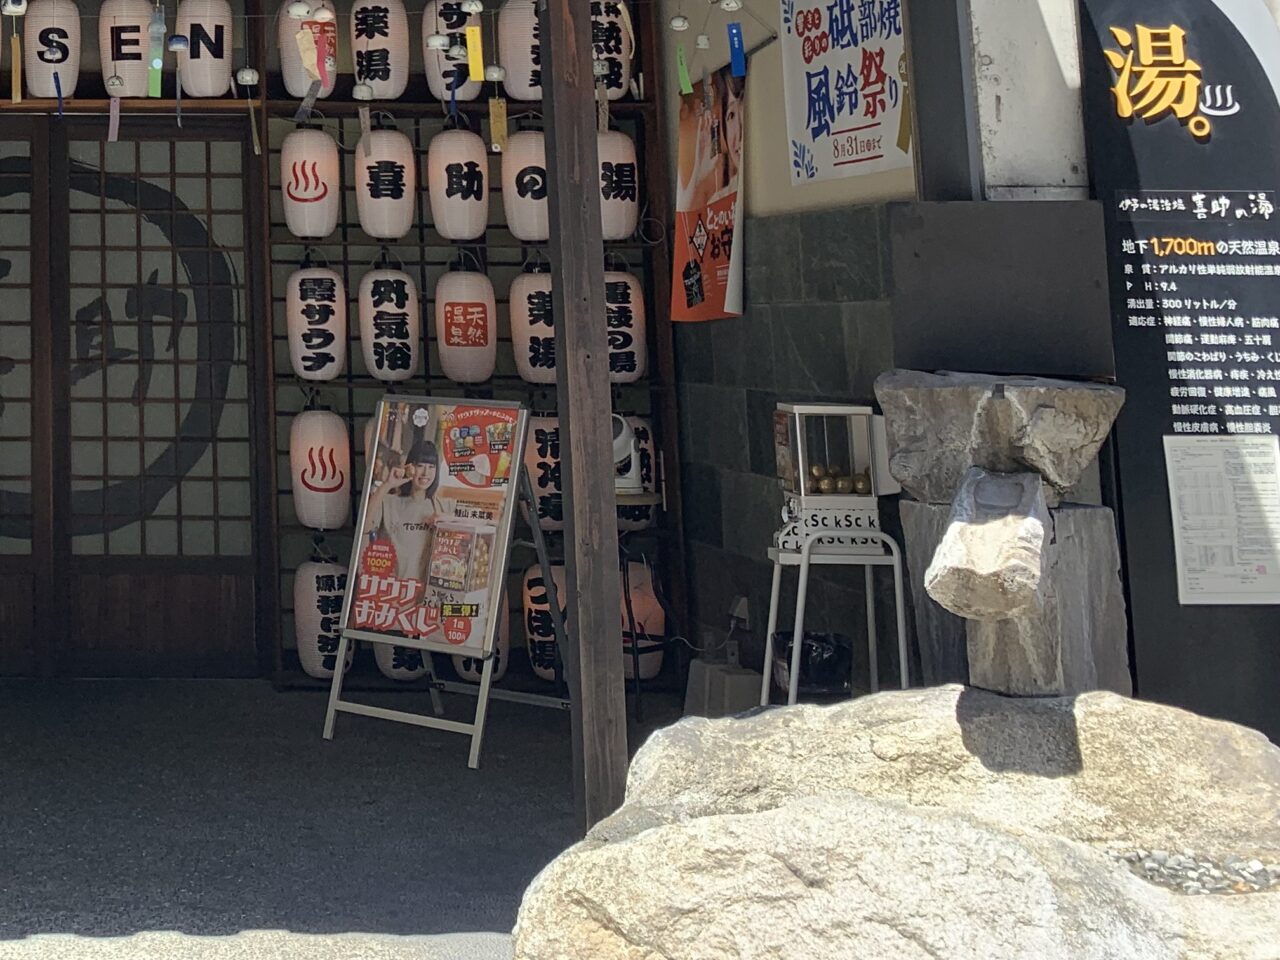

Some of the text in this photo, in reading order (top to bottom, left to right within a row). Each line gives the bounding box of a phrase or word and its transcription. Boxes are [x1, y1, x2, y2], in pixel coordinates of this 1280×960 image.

[806, 47, 898, 142] 風鈴祭り
[1191, 191, 1274, 220] 喜助の湯
[371, 279, 411, 370] 外気浴
[359, 574, 421, 603] サウナ
[355, 600, 438, 633] おみくじ
